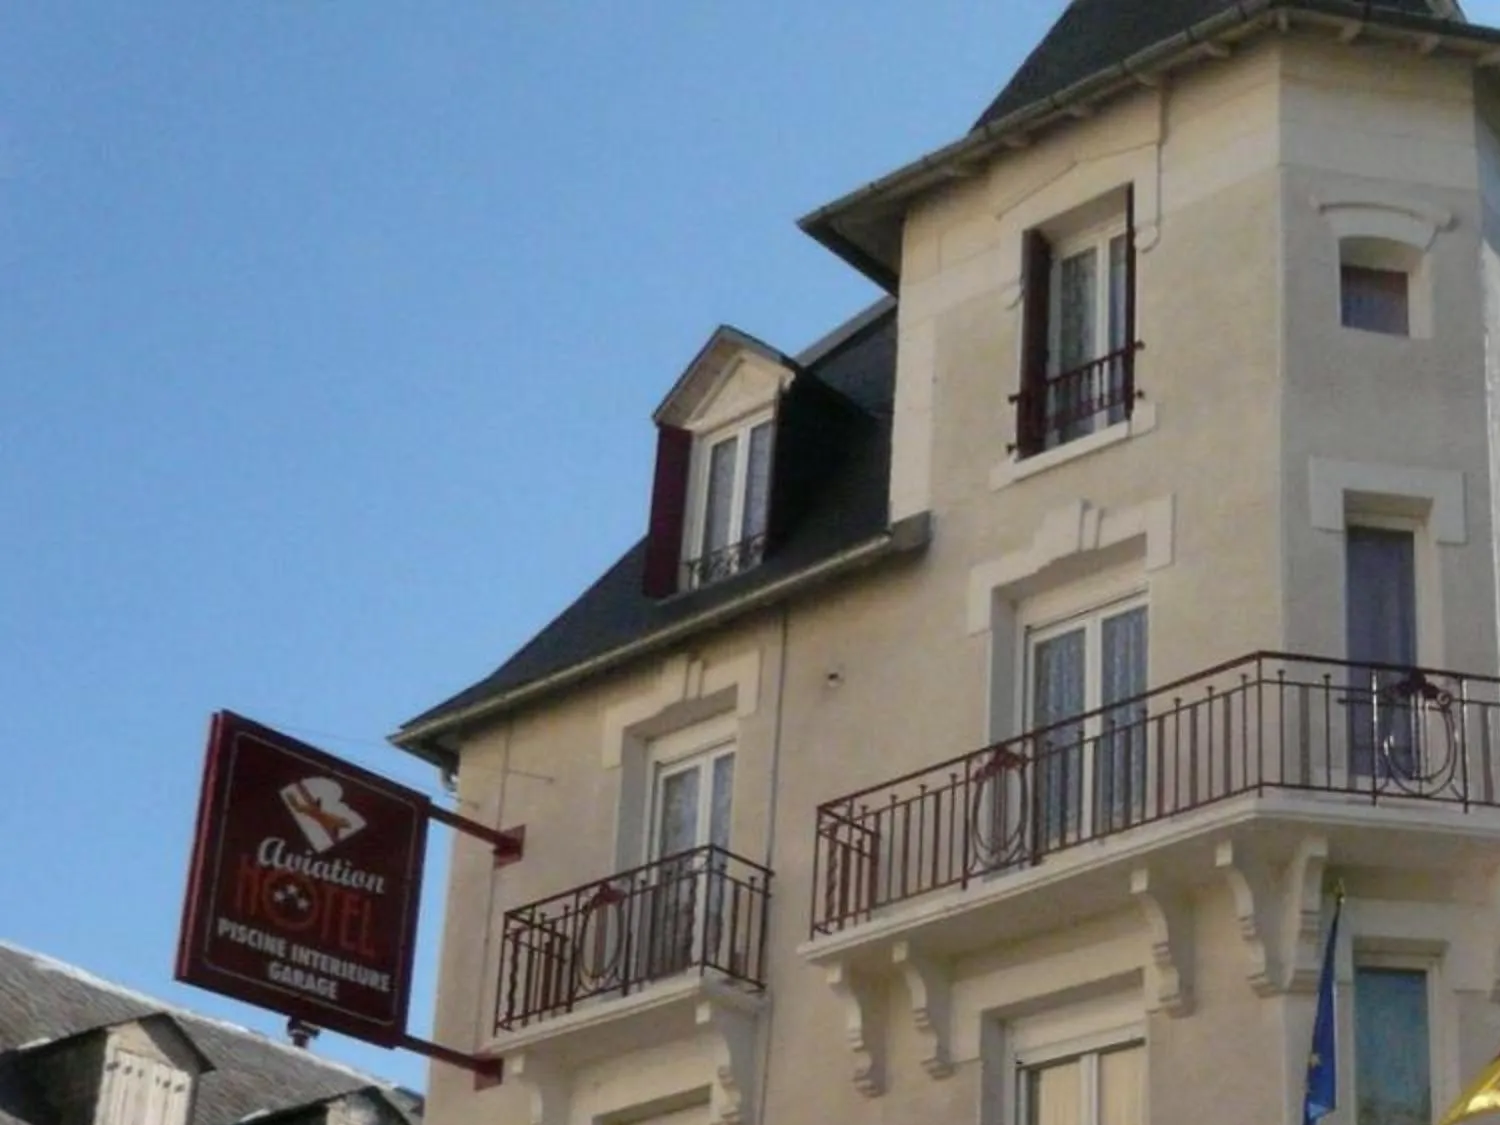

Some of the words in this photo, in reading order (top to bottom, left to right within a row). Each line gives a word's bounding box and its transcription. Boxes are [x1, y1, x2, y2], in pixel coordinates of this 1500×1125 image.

[257, 837, 386, 894] Aviation
[235, 854, 377, 958] HOTEL
[217, 917, 286, 957] PISCINE
[291, 943, 391, 992] INTERIEURE
[268, 960, 339, 999] GARAGE
